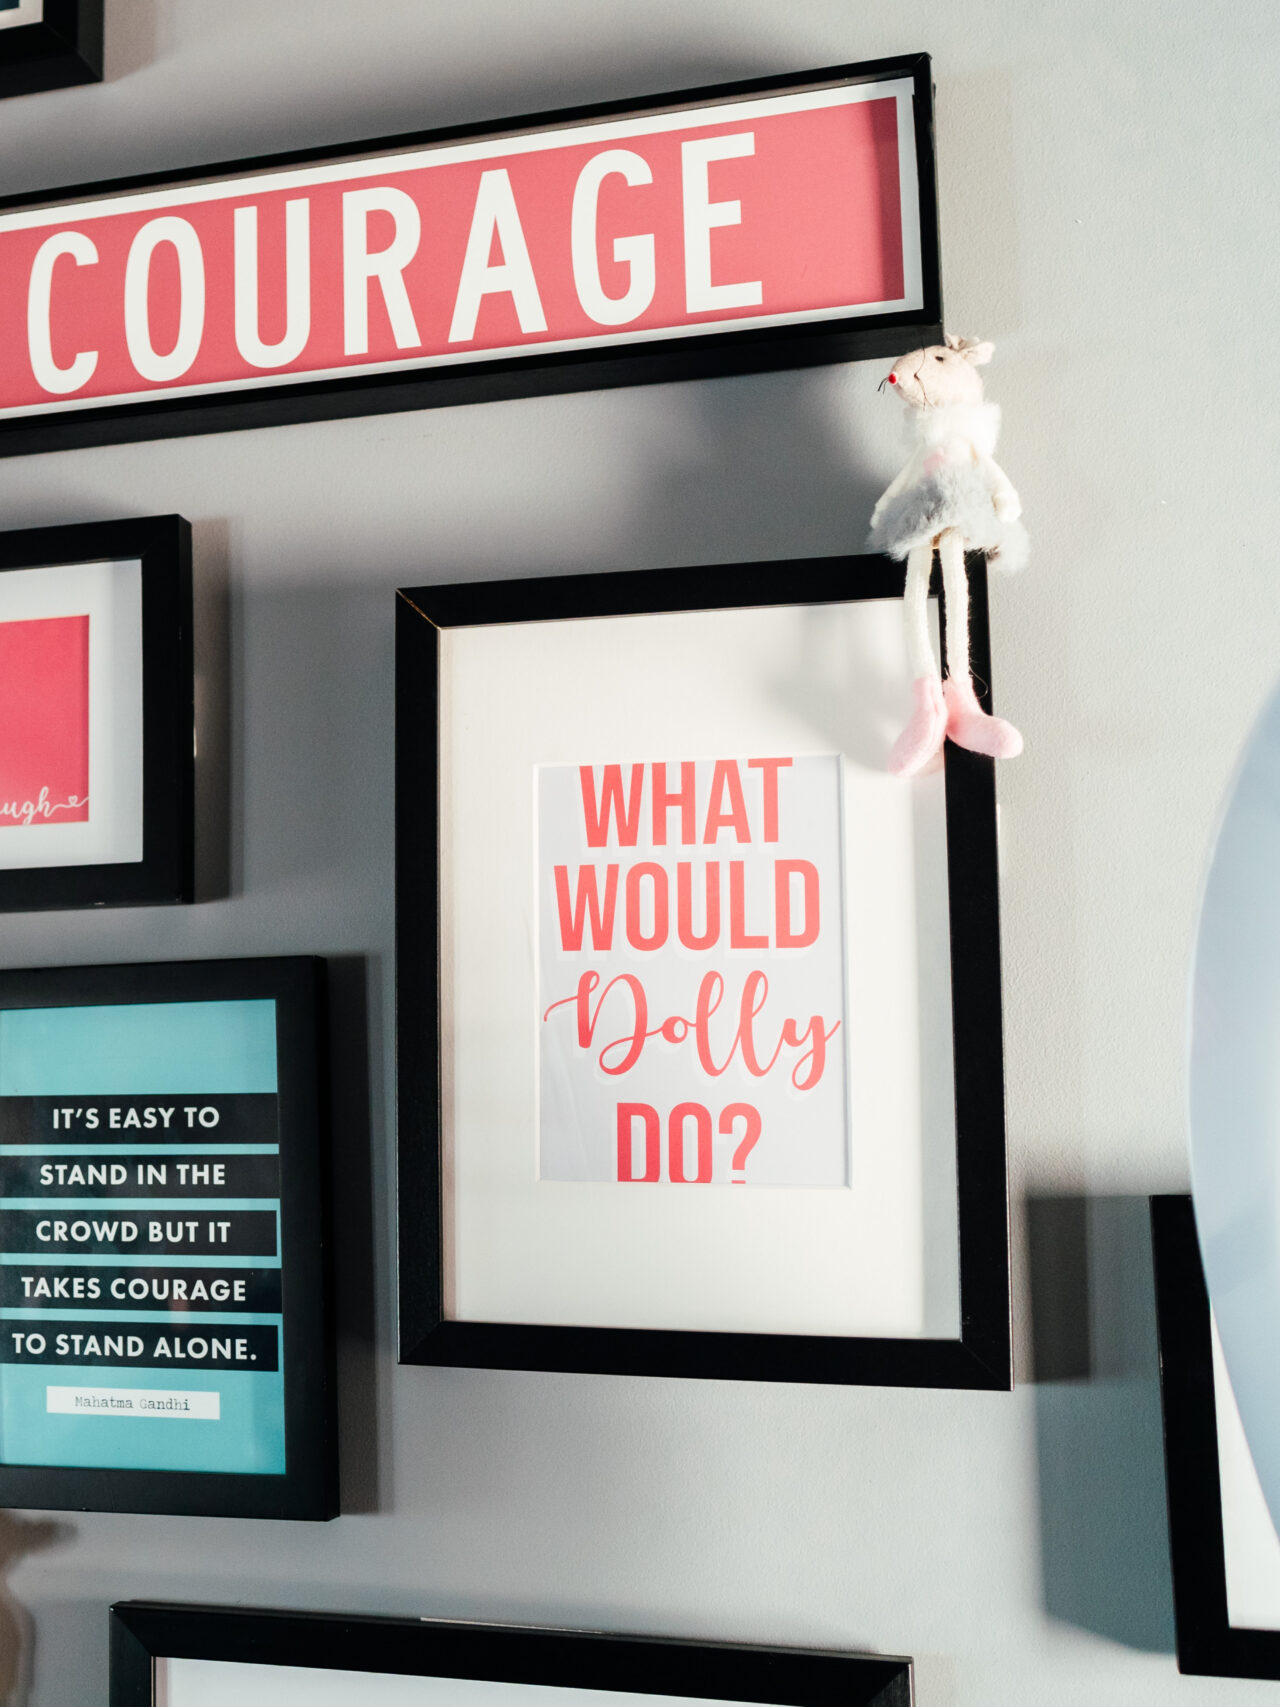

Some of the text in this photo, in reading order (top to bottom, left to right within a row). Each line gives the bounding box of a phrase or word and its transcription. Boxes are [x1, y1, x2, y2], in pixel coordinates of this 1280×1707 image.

[27, 131, 763, 394] COURAGE
[579, 757, 793, 848] WHAT
[554, 859, 821, 951] WOULD
[544, 970, 841, 1091] Dolly
[52, 1106, 220, 1129] IT’S EASY TO
[617, 1102, 762, 1184] DO?
[39, 1164, 226, 1185] STAND IN THE
[35, 1220, 231, 1243] CROWD BUT IT
[21, 1276, 247, 1302] TAKES COURAGE
[11, 1333, 257, 1361] TO STAND ALONE.
[74, 1395, 191, 1412] Mahatma Gandhi
